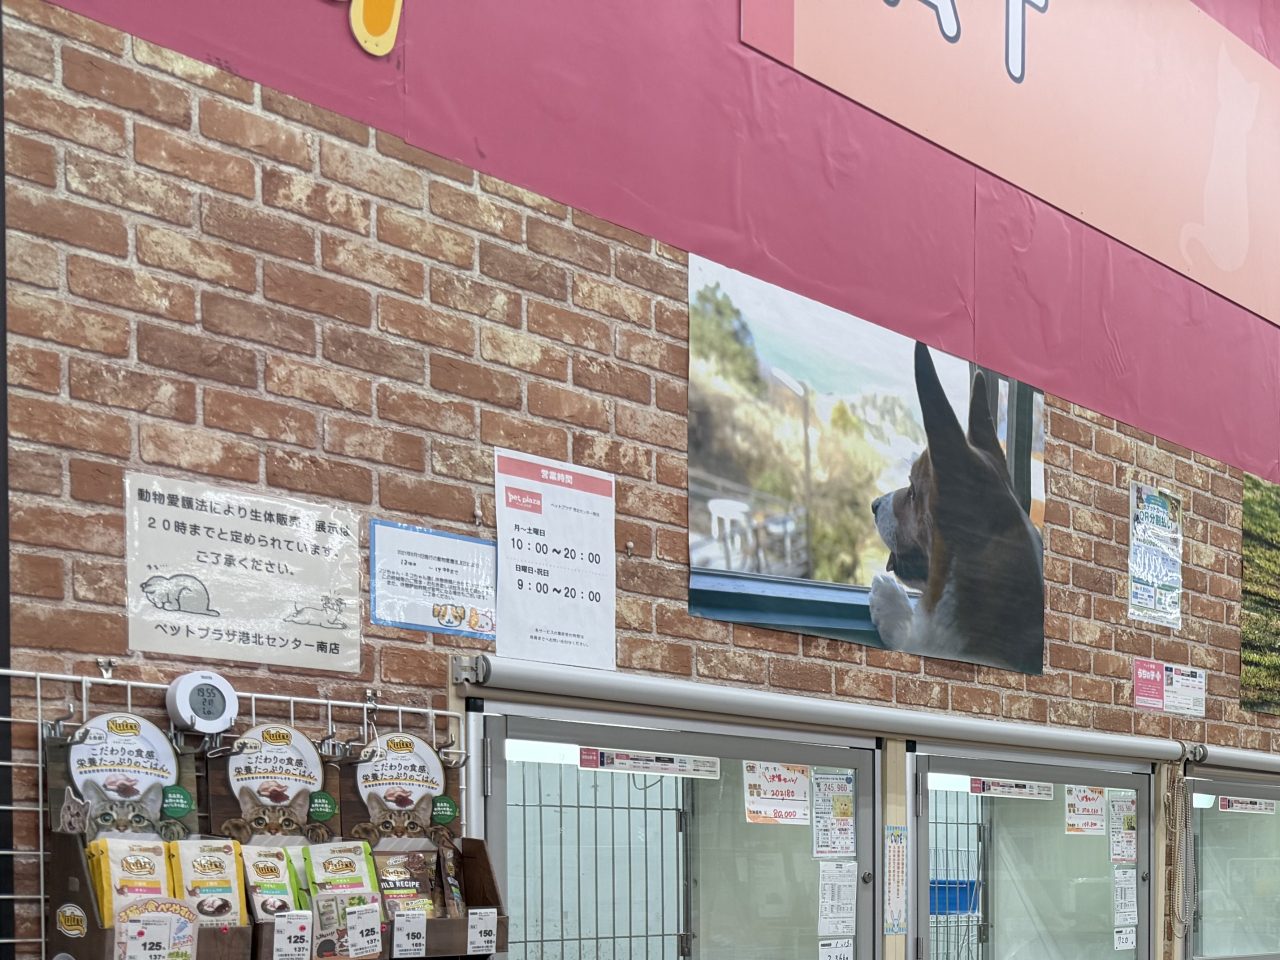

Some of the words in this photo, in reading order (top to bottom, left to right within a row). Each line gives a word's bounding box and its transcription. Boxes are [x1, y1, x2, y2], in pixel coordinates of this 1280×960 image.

[541, 469, 573, 485] 営業時間
[522, 495, 541, 507] plaza
[196, 550, 294, 576] ご了承ください。
[155, 623, 340, 655] ペットプラザ港北センター南店
[107, 719, 141, 737] Nutro
[262, 730, 292, 745] Nutro
[386, 739, 415, 753] Nutro
[91, 747, 159, 762] こだわりの食感、
[76, 758, 172, 775] 栄養たっぷりのごはん。
[247, 756, 308, 769] こだわりの食感、
[374, 763, 431, 775] こだわりの食感、
[234, 767, 319, 780] 栄養たっぷりのごはん。
[362, 773, 440, 786] 栄養たっぷりのごはん。
